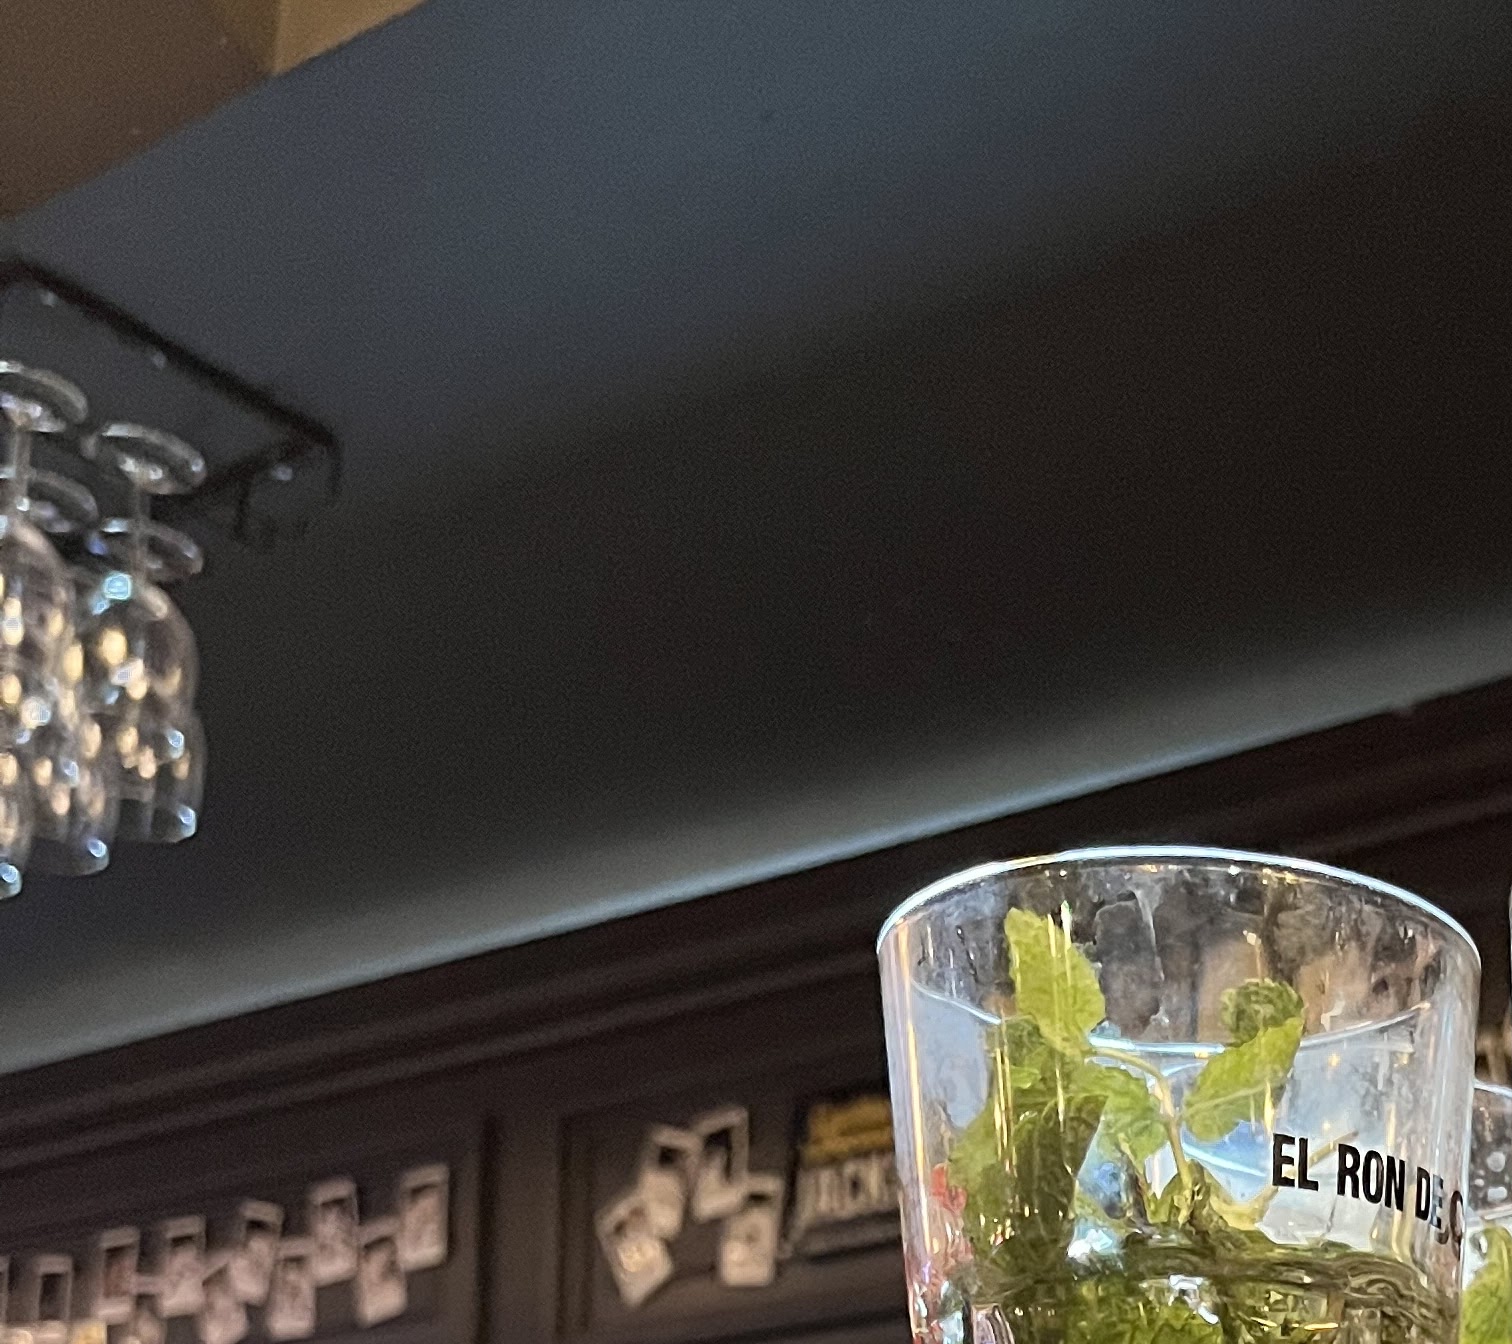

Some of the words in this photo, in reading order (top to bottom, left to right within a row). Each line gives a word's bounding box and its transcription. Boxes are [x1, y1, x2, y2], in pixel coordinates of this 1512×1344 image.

[1272, 1133, 1319, 1191] EL
[1337, 1143, 1406, 1212] RON
[1415, 1166, 1444, 1230] DE
